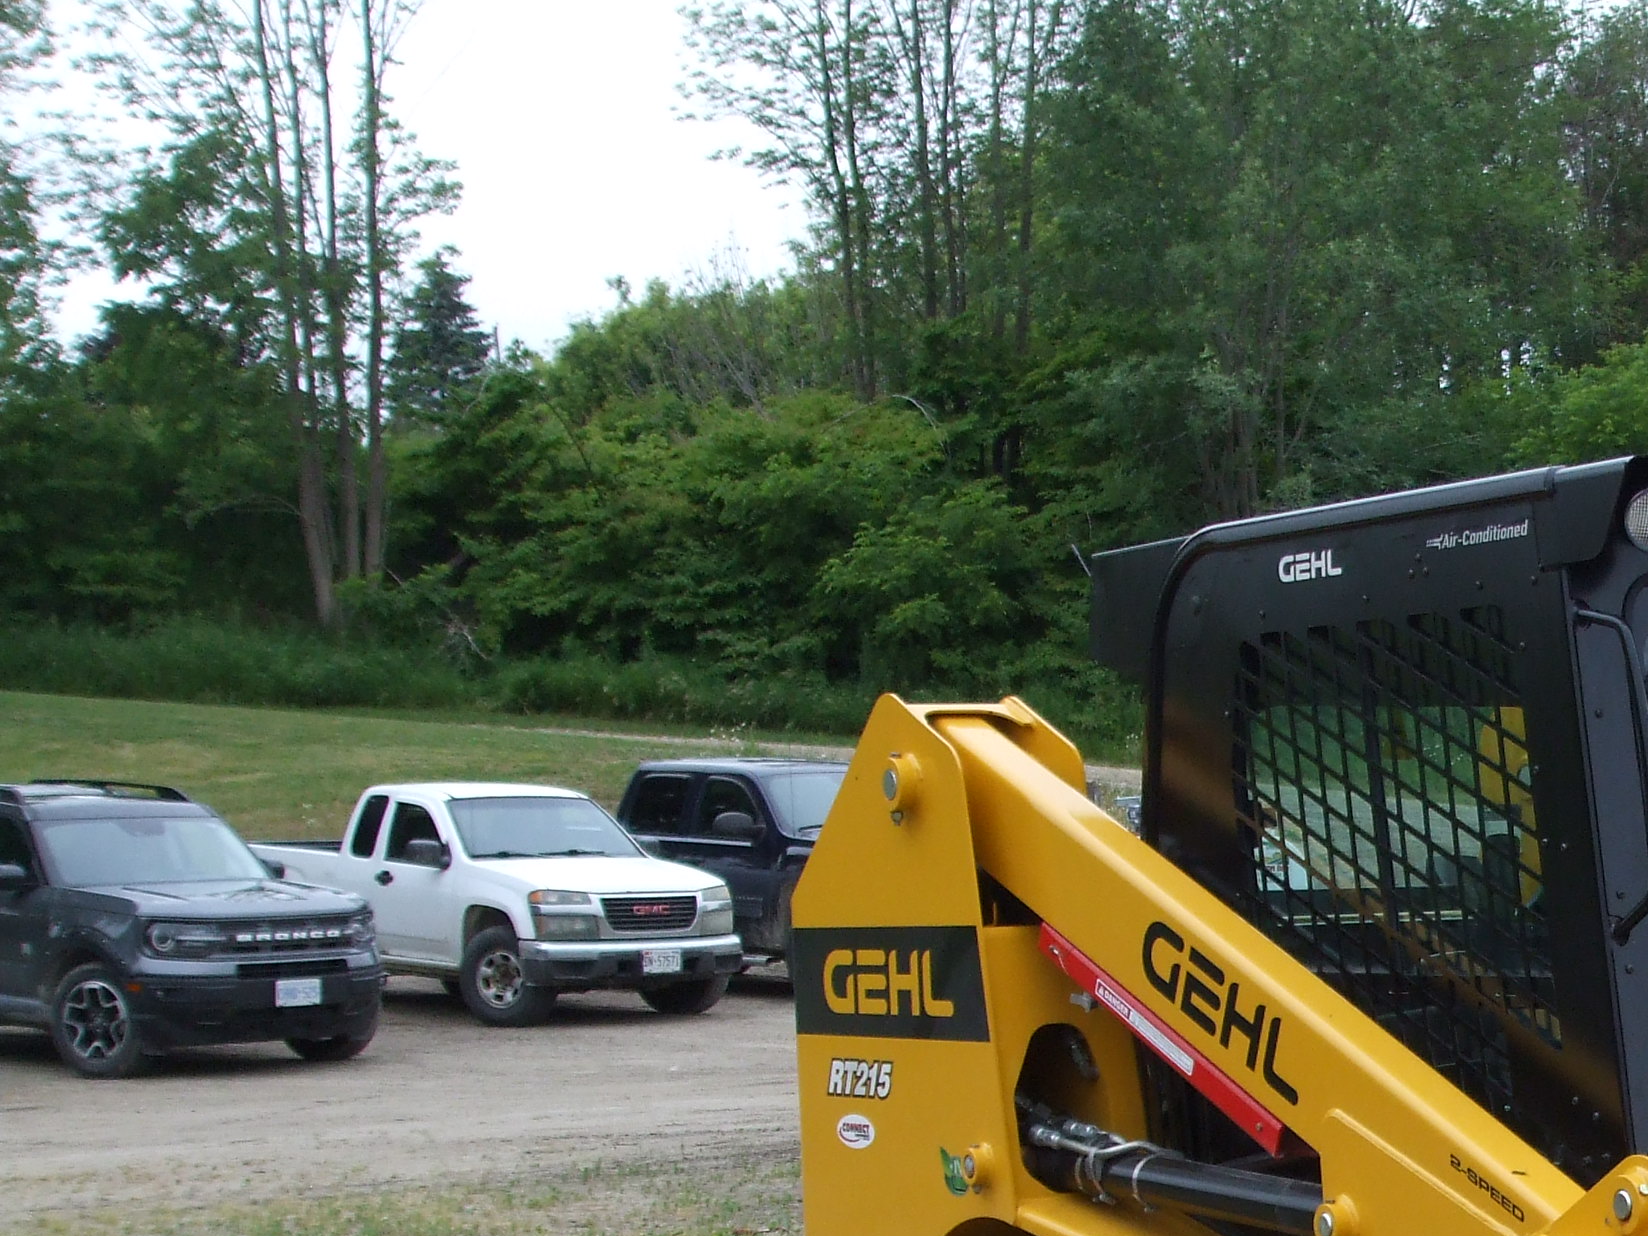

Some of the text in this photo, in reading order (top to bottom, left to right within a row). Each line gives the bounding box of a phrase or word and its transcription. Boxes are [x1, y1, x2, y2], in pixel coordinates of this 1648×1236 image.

[1441, 519, 1529, 549] Air-Conditioned
[1278, 550, 1343, 583] GEHL
[632, 904, 671, 915] GMC
[236, 930, 341, 942] BRONCO
[823, 949, 955, 1018] GEHL
[1104, 990, 1130, 1018] DANGER
[1141, 920, 1299, 1107] GEHL
[827, 1058, 893, 1099] RT215
[842, 1122, 869, 1134] CONNECT
[1449, 1153, 1525, 1223] 2-SPEED
